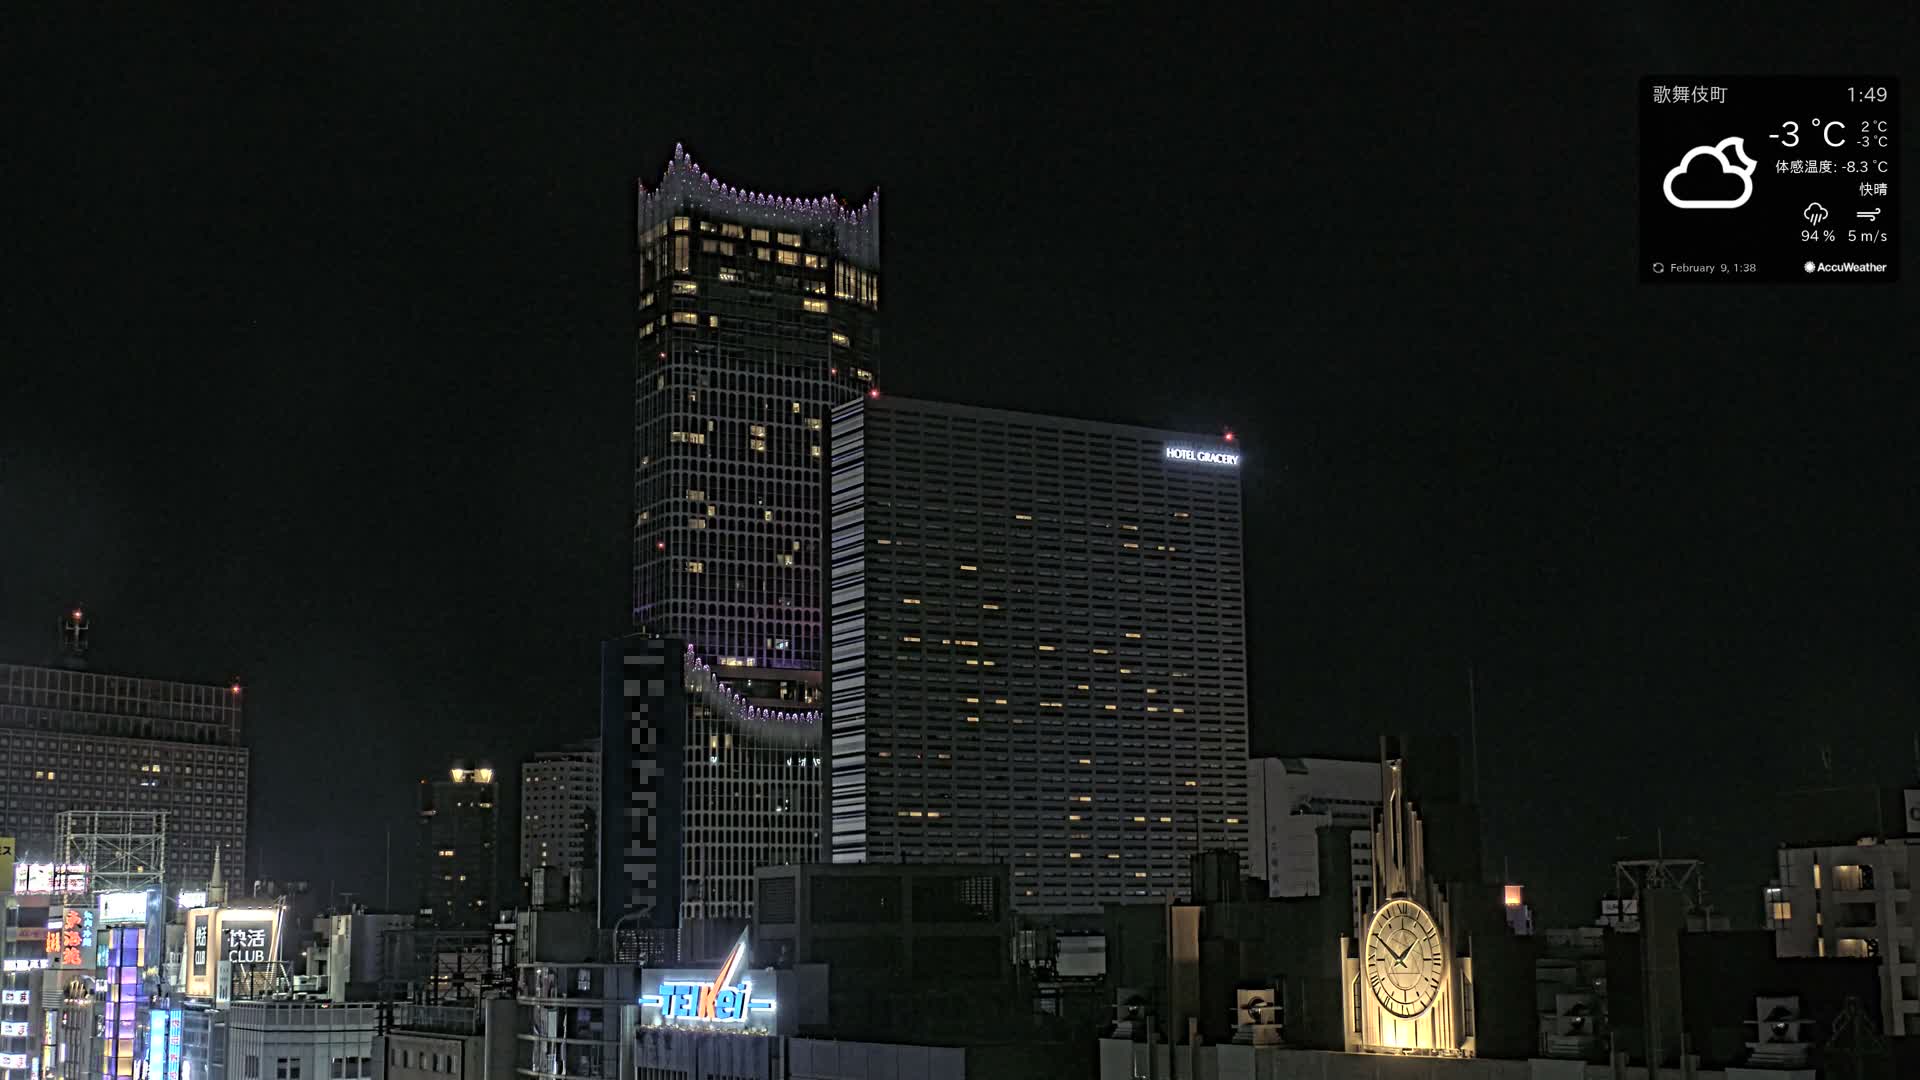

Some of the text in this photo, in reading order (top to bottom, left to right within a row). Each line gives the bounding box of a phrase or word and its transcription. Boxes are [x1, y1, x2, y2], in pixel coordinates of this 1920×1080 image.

[1166, 447, 1239, 465] HOTEL GRACERY
[227, 929, 265, 947] 快活
[229, 950, 265, 963] CLUB
